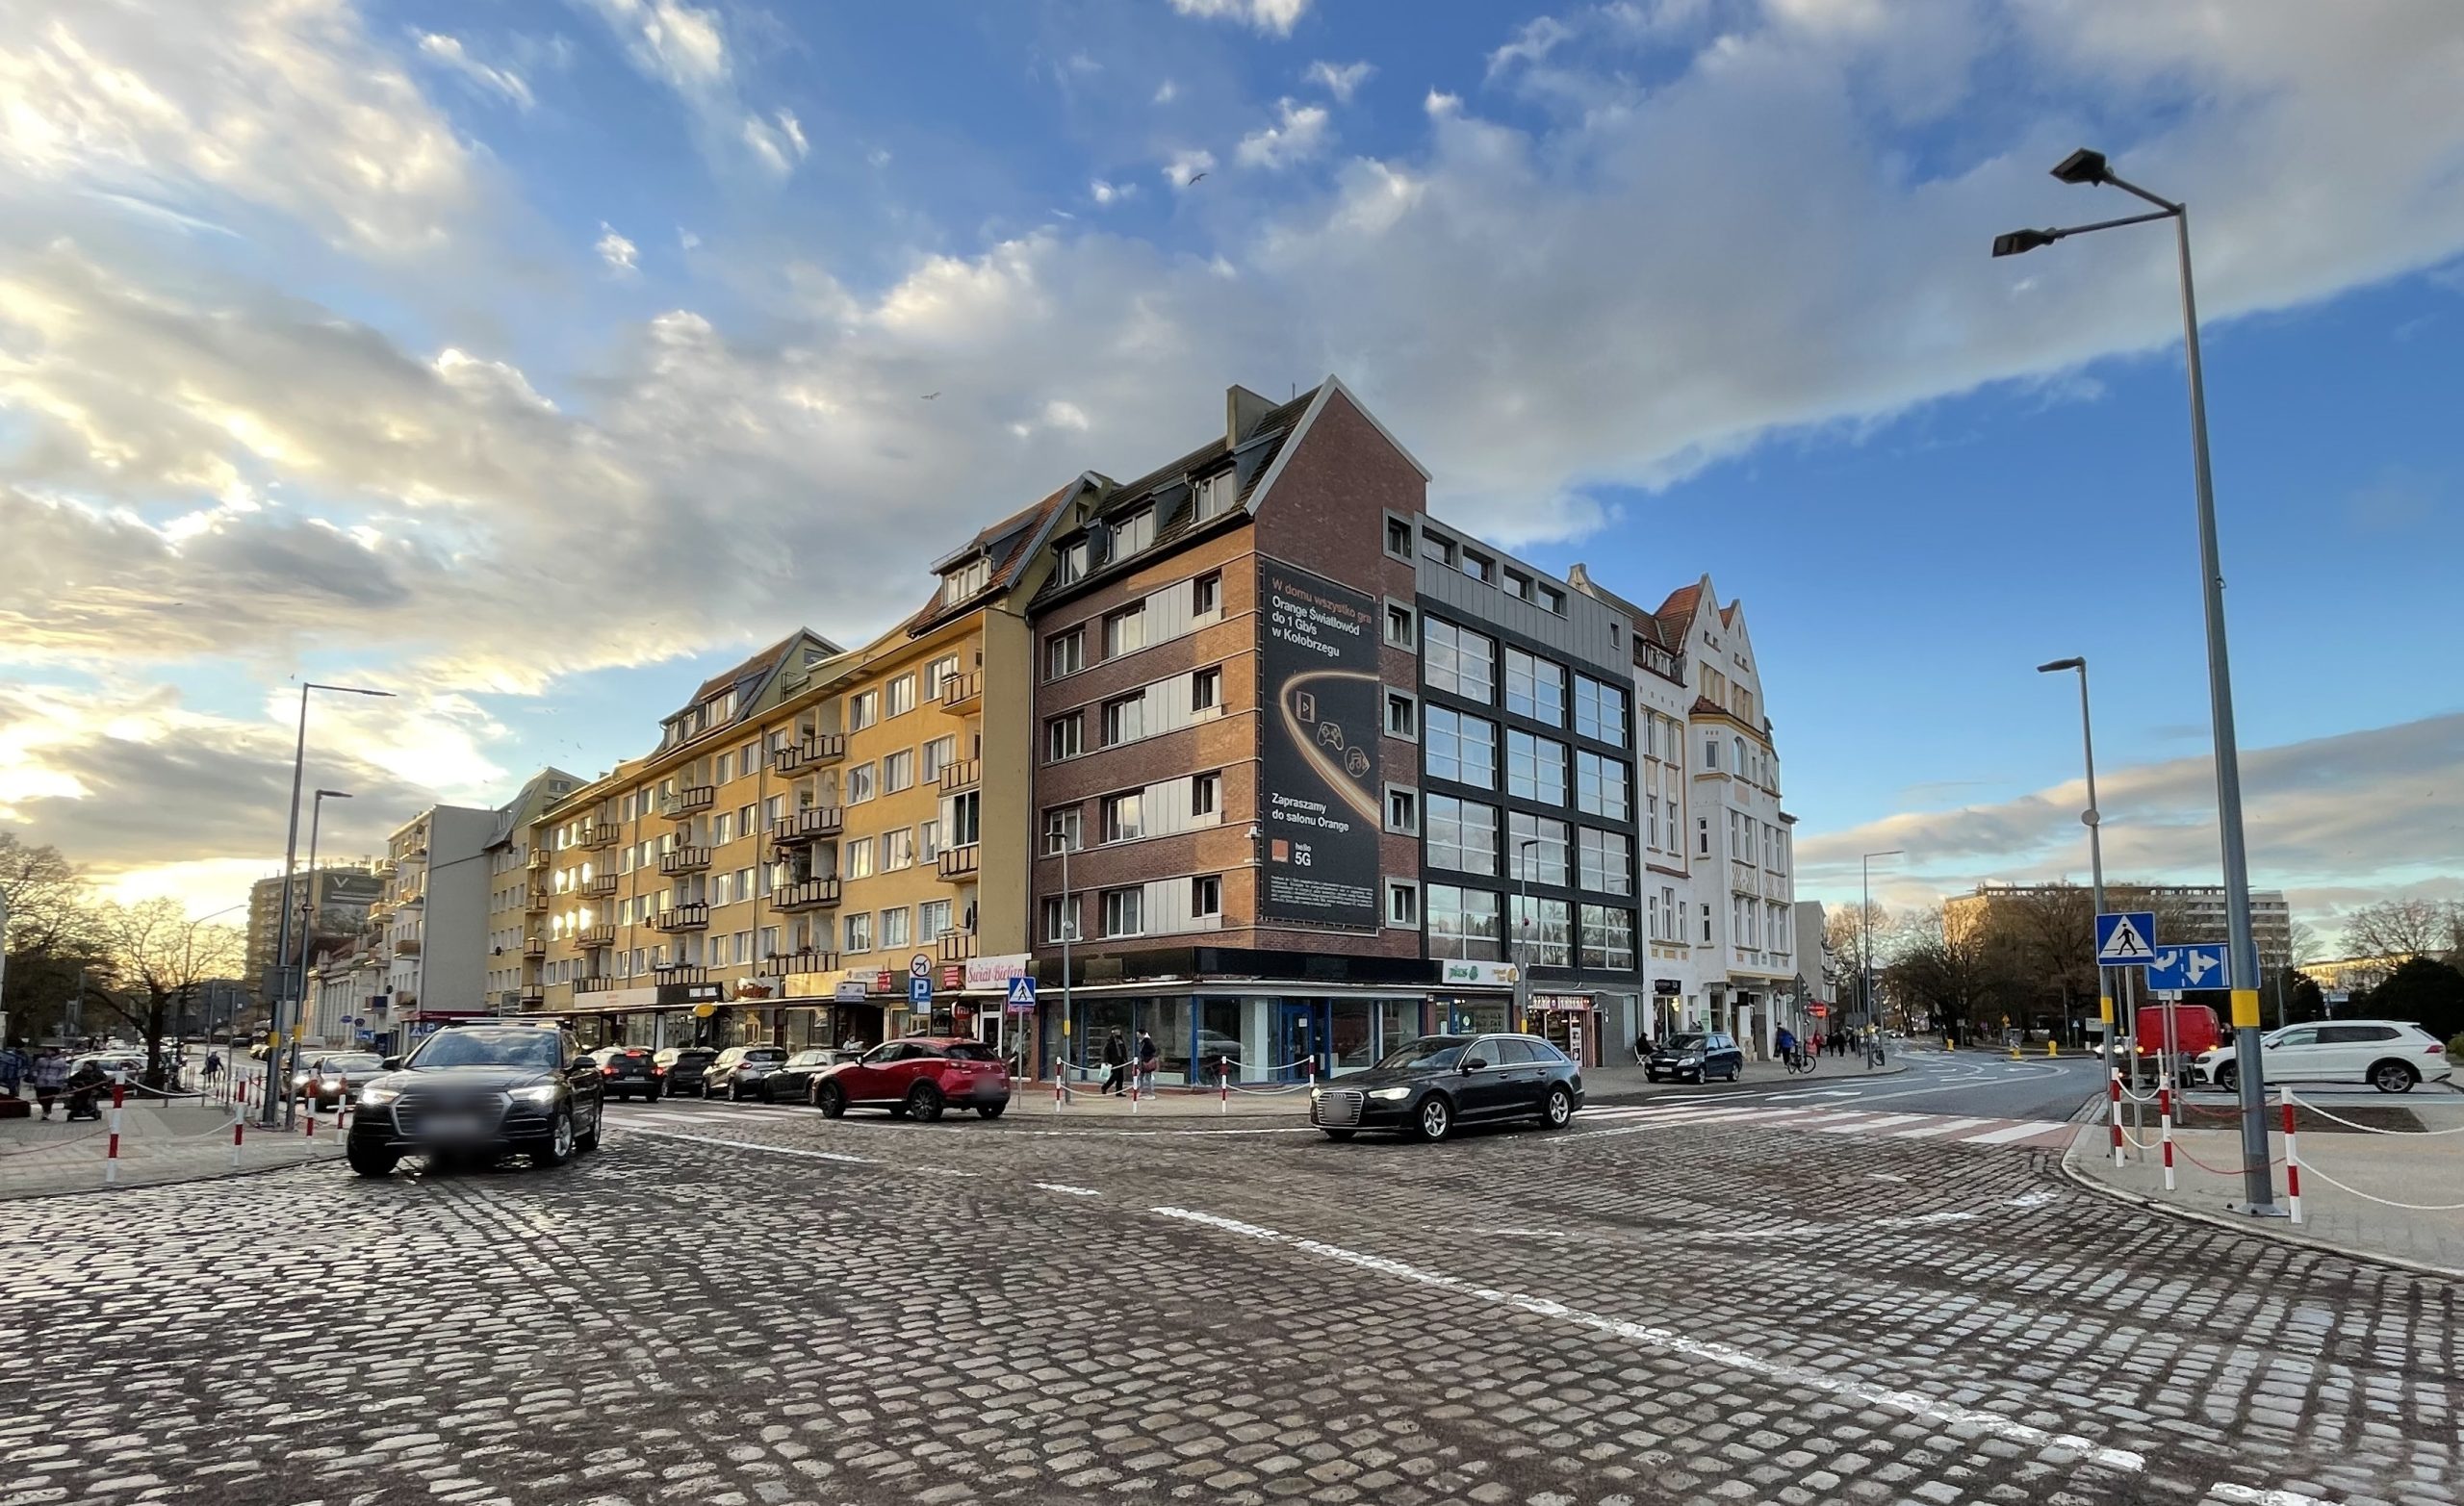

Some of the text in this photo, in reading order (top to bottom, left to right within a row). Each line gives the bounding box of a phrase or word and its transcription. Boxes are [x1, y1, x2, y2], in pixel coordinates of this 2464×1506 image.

[1272, 577, 1282, 591] W
[1285, 583, 1312, 602] domu
[1314, 597, 1355, 618] wszystko
[1271, 596, 1360, 636] Orange Światłowód
[1271, 611, 1318, 635] do 1 Gb/s
[1271, 626, 1340, 657] w Kołobrzegu
[1271, 793, 1327, 814] Zapraszamy
[1271, 809, 1349, 833] do salonu Orange
[1295, 852, 1312, 866] 5G
[914, 980, 928, 999] P
